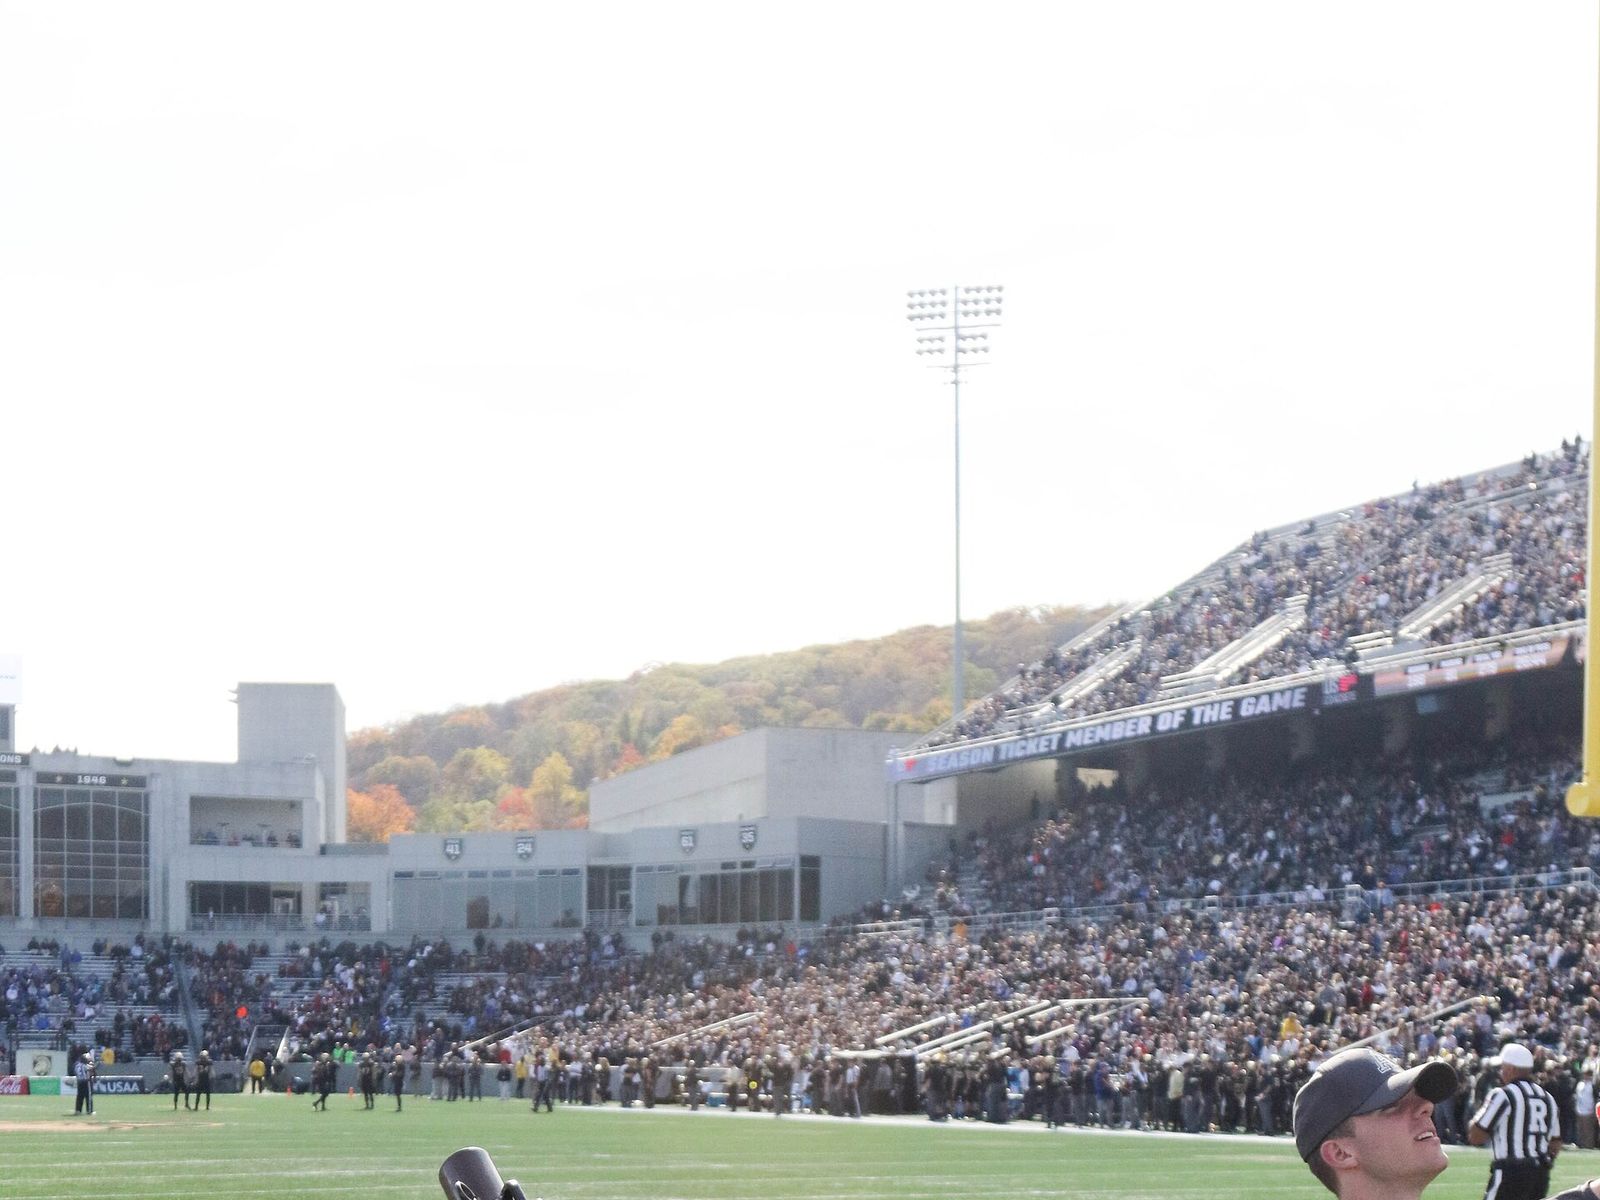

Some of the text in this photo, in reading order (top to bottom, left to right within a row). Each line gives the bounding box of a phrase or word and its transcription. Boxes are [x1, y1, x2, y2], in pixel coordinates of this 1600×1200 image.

[928, 746, 994, 772] SEASON
[999, 734, 1061, 760] TICKET
[1064, 715, 1152, 748] MEMBER
[1156, 709, 1187, 731] OF
[1192, 700, 1234, 725] THE
[1239, 686, 1307, 717] GAME
[77, 775, 107, 785] 1946
[517, 843, 532, 854] 24
[107, 1081, 140, 1093] USAA
[1528, 1097, 1548, 1134] R
